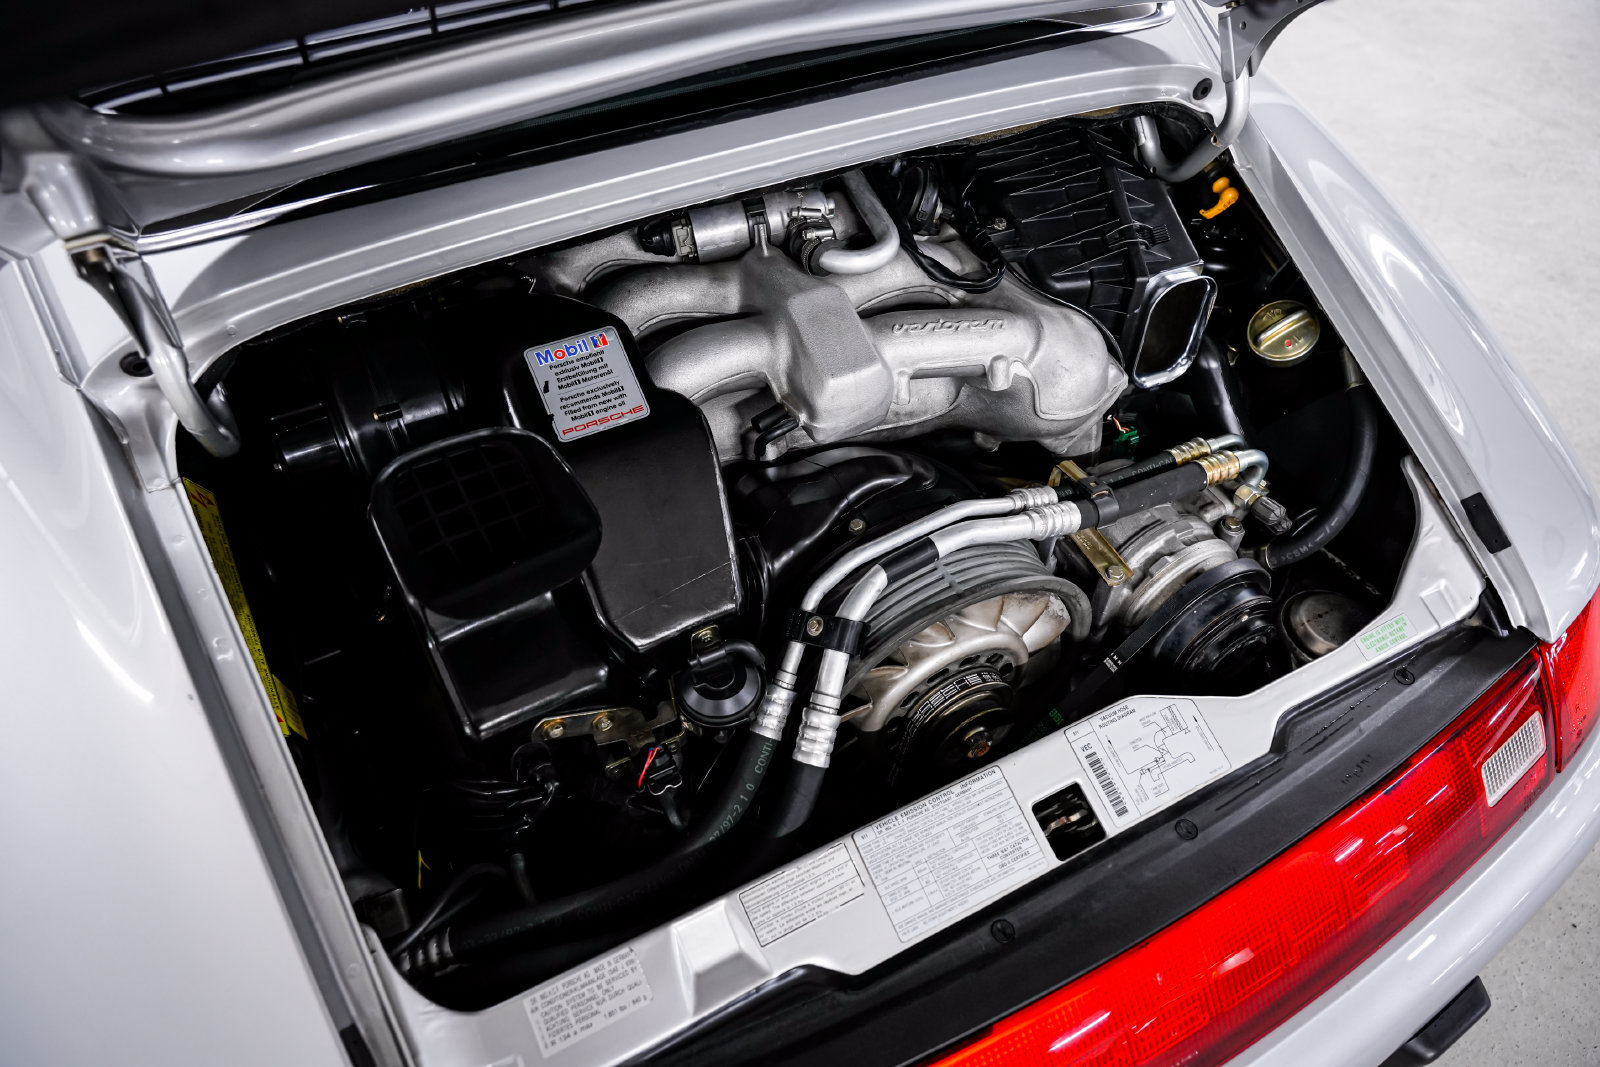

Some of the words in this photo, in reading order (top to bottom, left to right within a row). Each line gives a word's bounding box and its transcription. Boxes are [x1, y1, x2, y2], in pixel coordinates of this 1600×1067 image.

[534, 338, 589, 366] Mobil
[548, 358, 574, 370] Porsche
[574, 349, 605, 363] empfiehlt
[554, 364, 580, 376] exklusiv
[556, 366, 597, 384] Erstbefüllung
[581, 368, 613, 383] Motorenöl
[559, 390, 585, 403] Porsche
[585, 379, 620, 395] exclusively
[559, 392, 600, 411] recommends
[564, 406, 581, 416] Filled
[581, 401, 597, 411] from
[598, 397, 612, 406] new
[612, 392, 627, 401] with
[595, 403, 617, 415] engine
[562, 404, 644, 436] PORSCHE
[1098, 716, 1117, 730] ROUTING
[1116, 706, 1136, 720] DIAGRAM
[1100, 709, 1118, 722] VACUUM
[1117, 703, 1129, 713] HOSE
[1080, 742, 1092, 752] VEC
[874, 815, 899, 830] VEHICLE
[899, 801, 927, 818] EMISSION
[927, 788, 954, 805] CONTROL
[958, 768, 996, 789] INFORMATION
[986, 851, 999, 861] THREE
[1009, 836, 1029, 849] CATALYTIC
[999, 845, 1022, 860] CONVERTER
[1010, 849, 1030, 863] CERTIFIED
